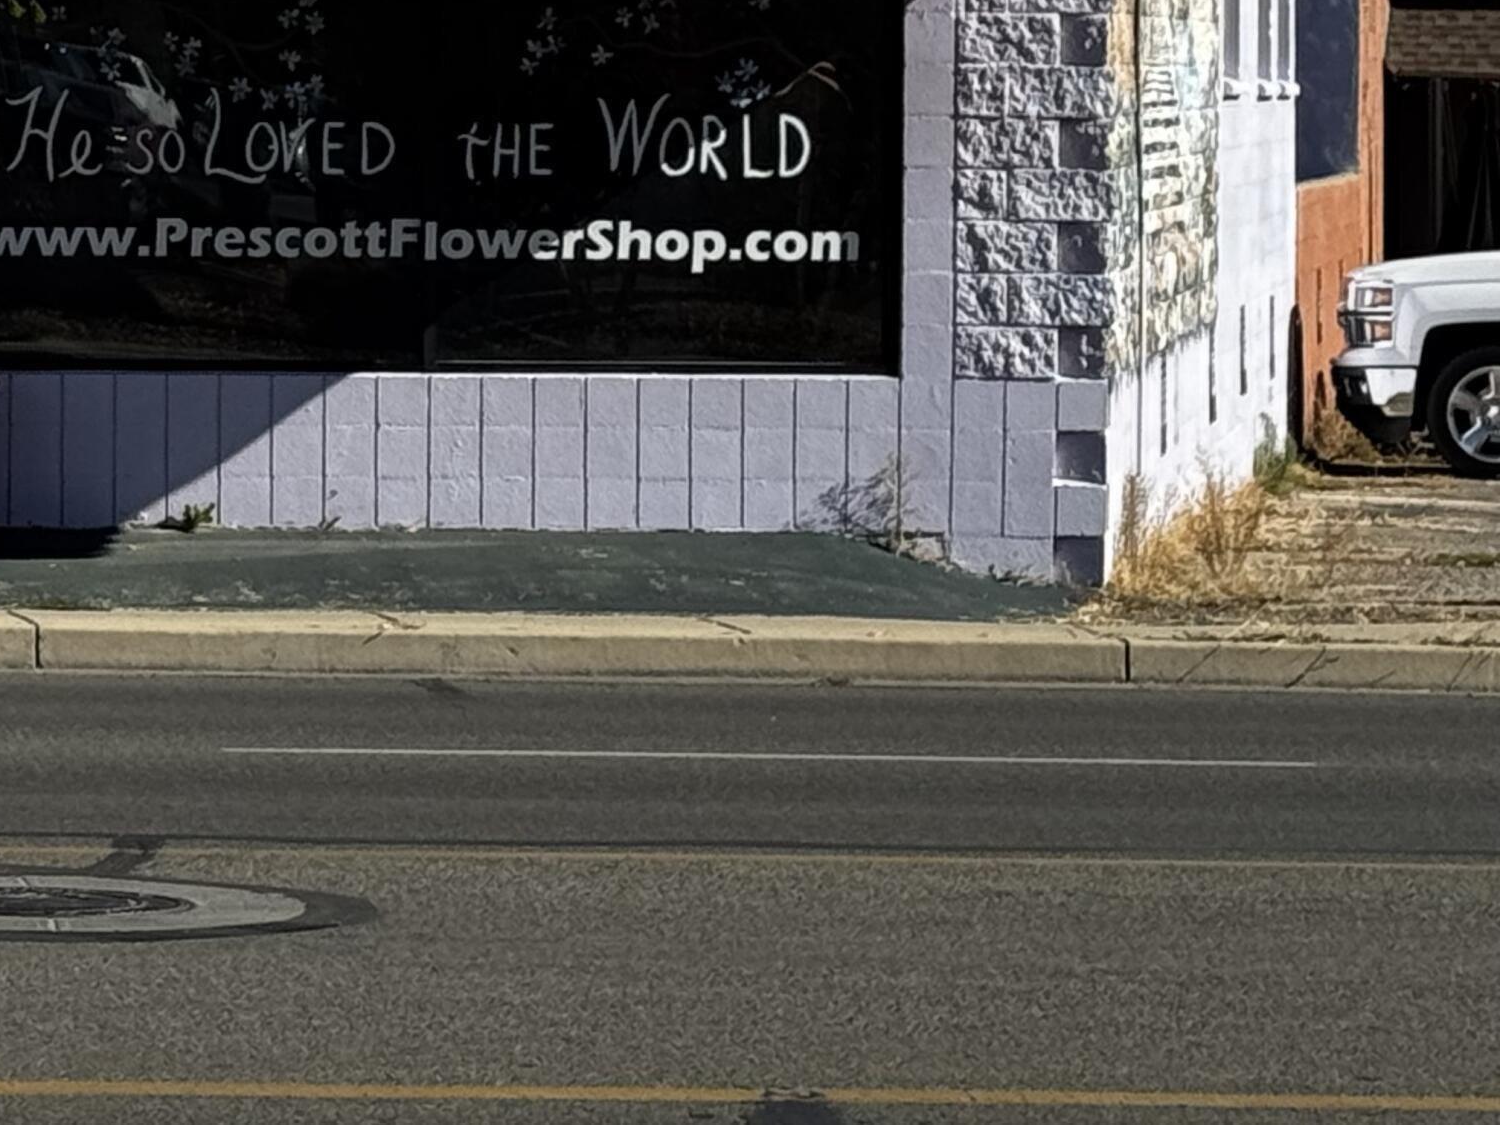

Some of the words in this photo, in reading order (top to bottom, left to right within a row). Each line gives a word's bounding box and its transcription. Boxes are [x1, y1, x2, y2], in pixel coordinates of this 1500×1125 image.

[5, 85, 103, 183] He
[203, 86, 396, 184] LOVED
[596, 92, 813, 182] WORLD
